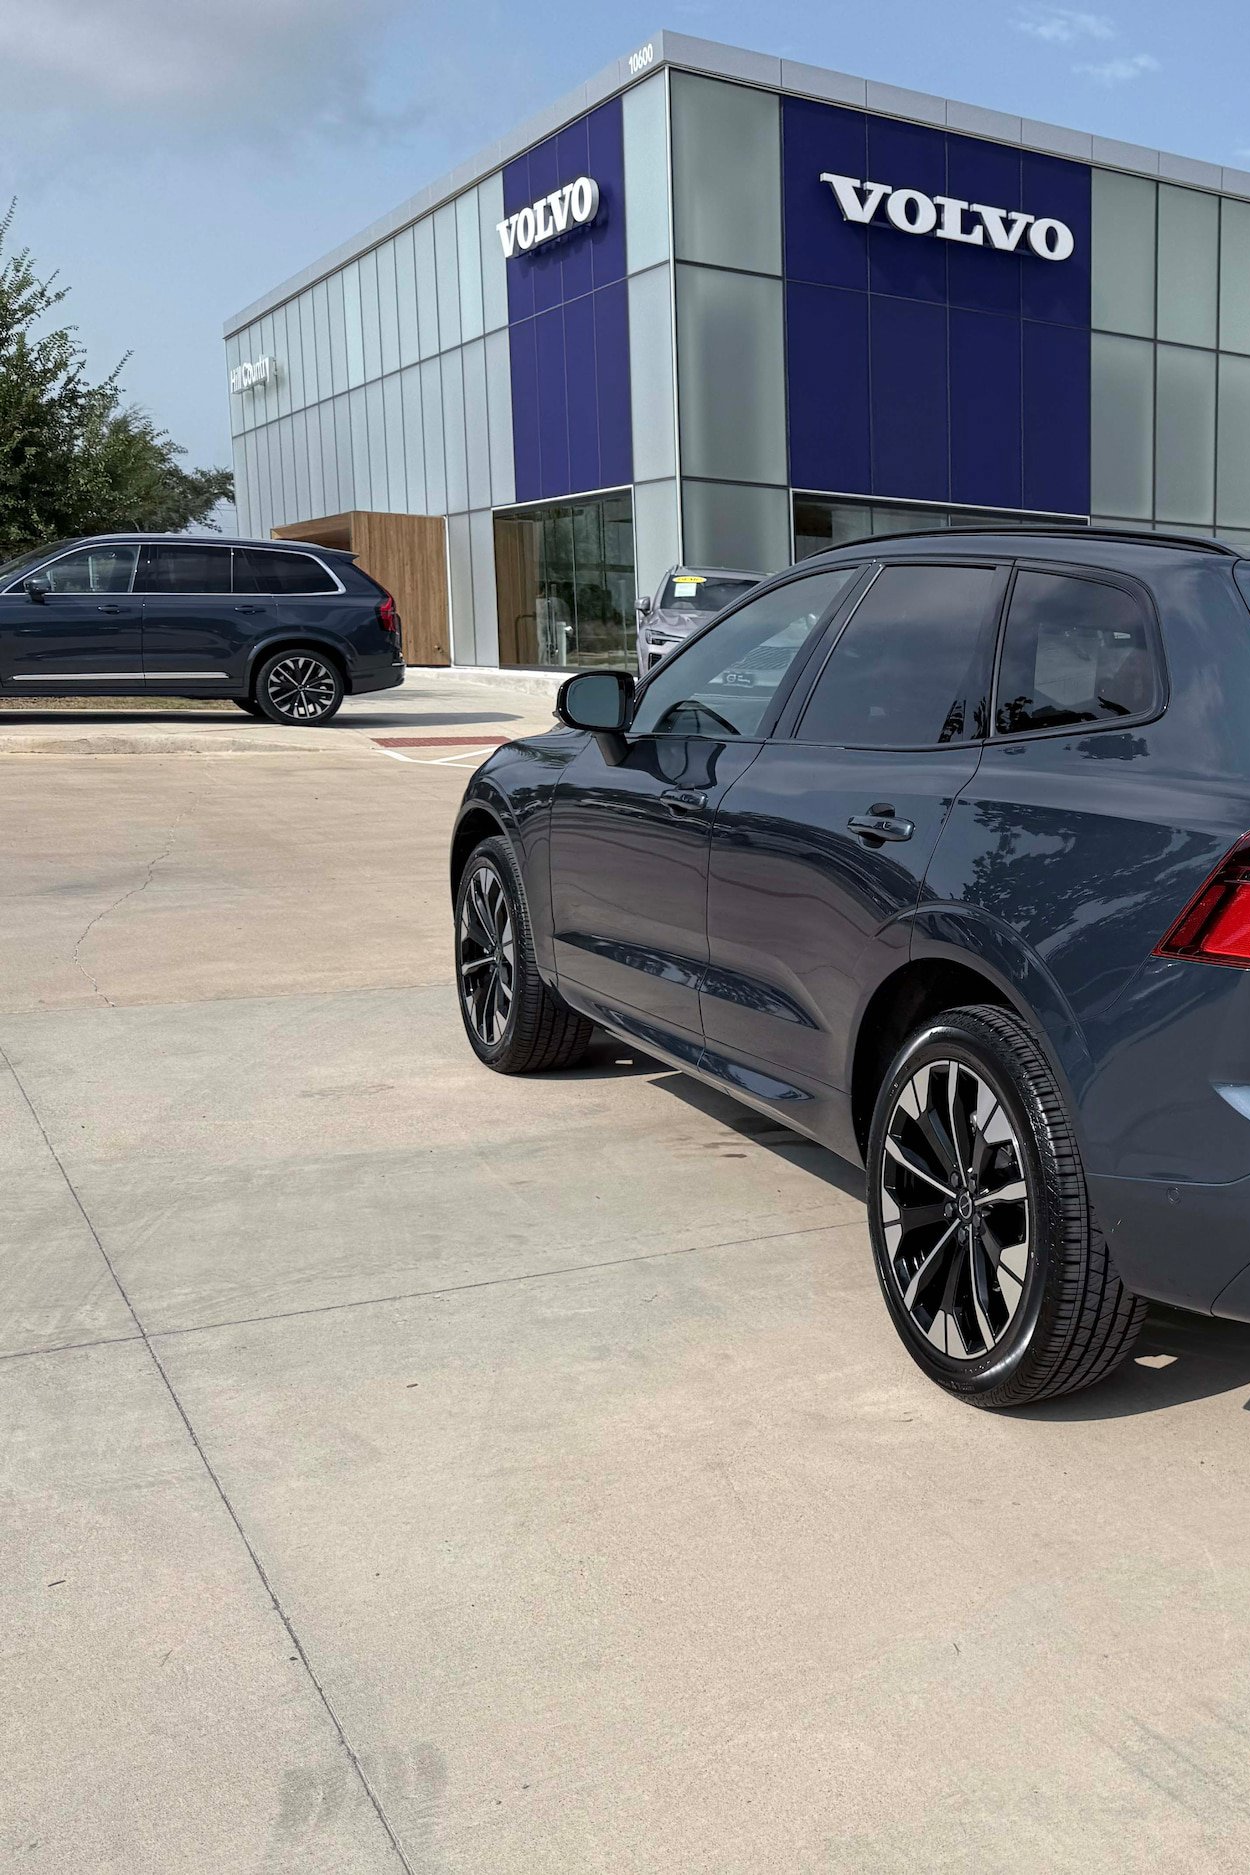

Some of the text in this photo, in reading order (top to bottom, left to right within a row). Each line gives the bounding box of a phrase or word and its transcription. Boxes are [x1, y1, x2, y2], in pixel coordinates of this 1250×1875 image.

[629, 43, 653, 74] 10600
[496, 176, 600, 258] VOLVO
[820, 172, 1075, 261] VOLVO
